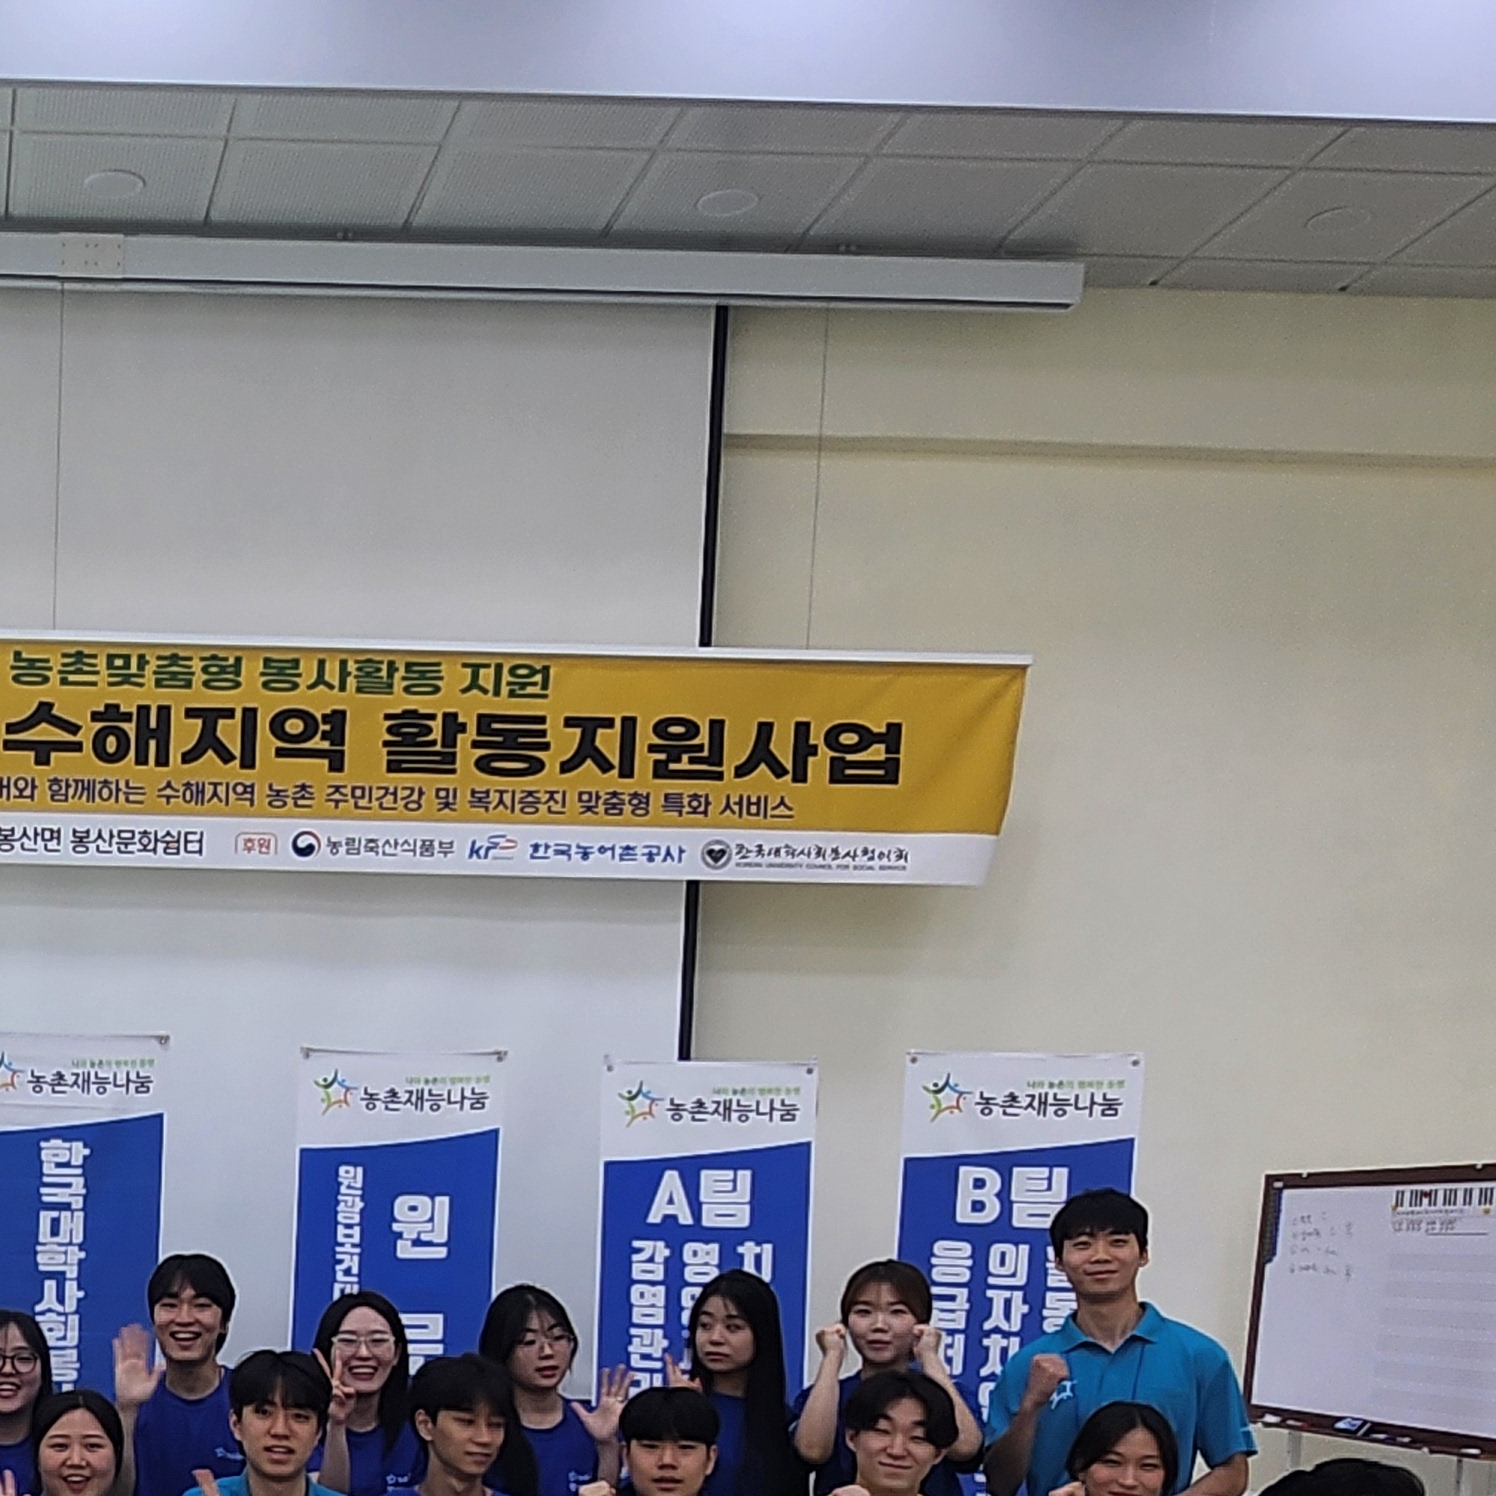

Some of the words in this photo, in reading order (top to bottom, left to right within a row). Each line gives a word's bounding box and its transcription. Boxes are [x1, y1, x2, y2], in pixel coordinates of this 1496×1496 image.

[10, 650, 243, 692] 농촌맞춤형
[259, 656, 444, 697] 봉사활동
[460, 661, 552, 701] 지원
[3, 701, 348, 774] 수해지역
[381, 709, 904, 786] 활동지원사업
[47, 777, 146, 805] 함께하는
[156, 779, 255, 808] 수해지역
[265, 782, 315, 809] 농촌
[325, 784, 426, 812] 주민건강
[435, 786, 458, 813] 및
[468, 787, 567, 816] 복지증진
[577, 788, 651, 818] 맞춤형
[661, 791, 710, 819] 특화
[719, 792, 794, 820] 서비스
[69, 827, 204, 858] 봉산문화쉼터
[242, 837, 271, 855] 후원
[326, 836, 455, 859] 농림축산식품부
[529, 840, 686, 865] 한국농어촌공사
[27, 1069, 154, 1096] 농촌재능나눔
[360, 1086, 490, 1112] 농촌재능나눔
[666, 1097, 800, 1123] 농촌재능나눔
[975, 1090, 1123, 1118] 농촌재능나눔
[645, 1169, 753, 1229] A팀
[955, 1165, 1070, 1230] B팀
